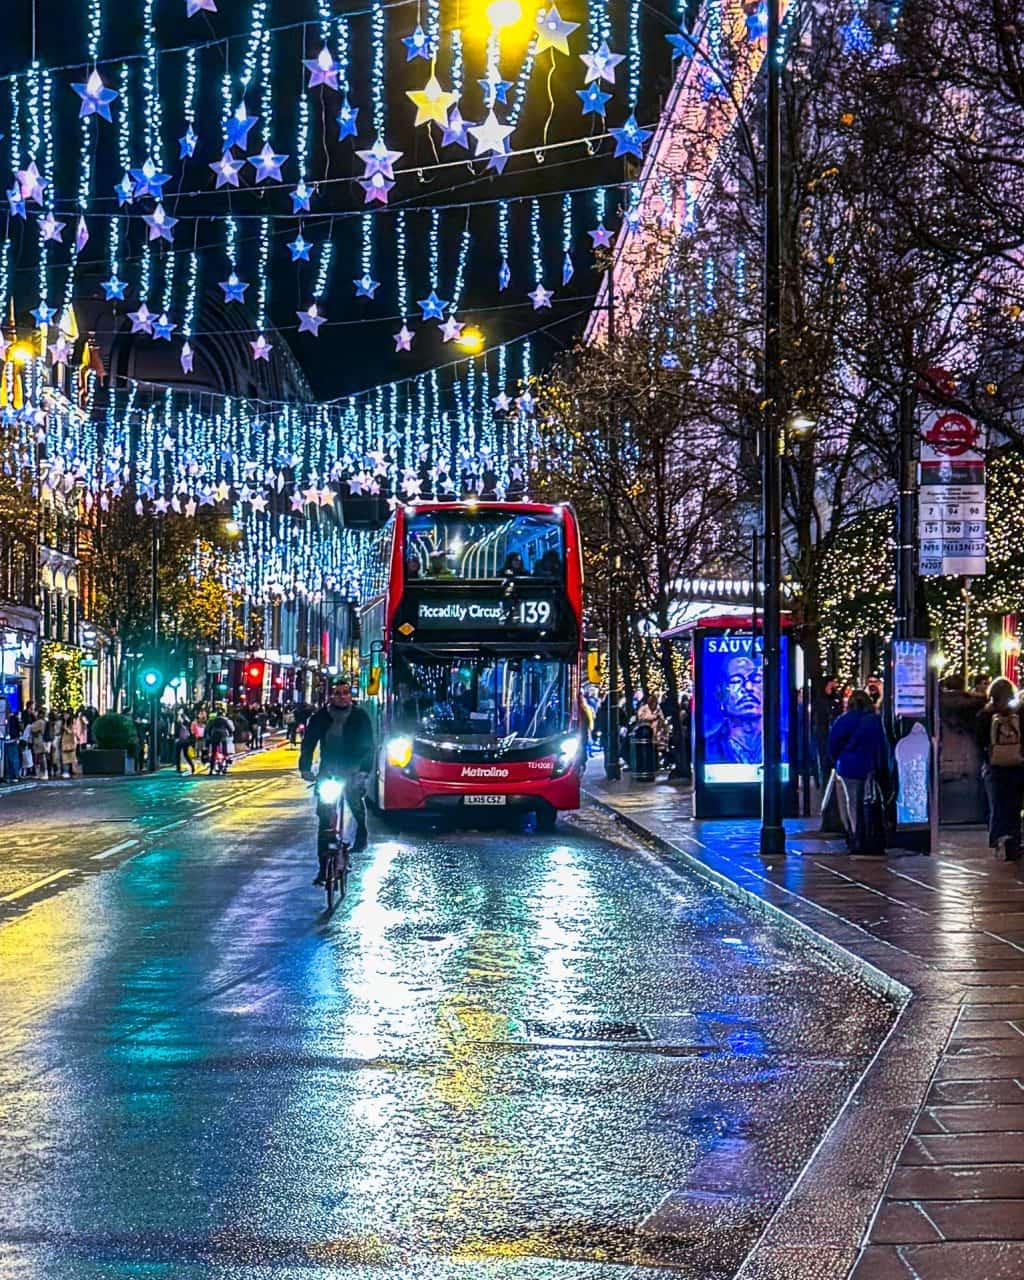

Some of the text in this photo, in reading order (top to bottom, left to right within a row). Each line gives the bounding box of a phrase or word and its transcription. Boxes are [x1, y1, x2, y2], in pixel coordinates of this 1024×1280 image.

[946, 525, 961, 533] 390
[419, 601, 550, 624] Piccadilly Circus 139
[708, 640, 762, 653] SAUVA
[461, 766, 509, 778] Metroline
